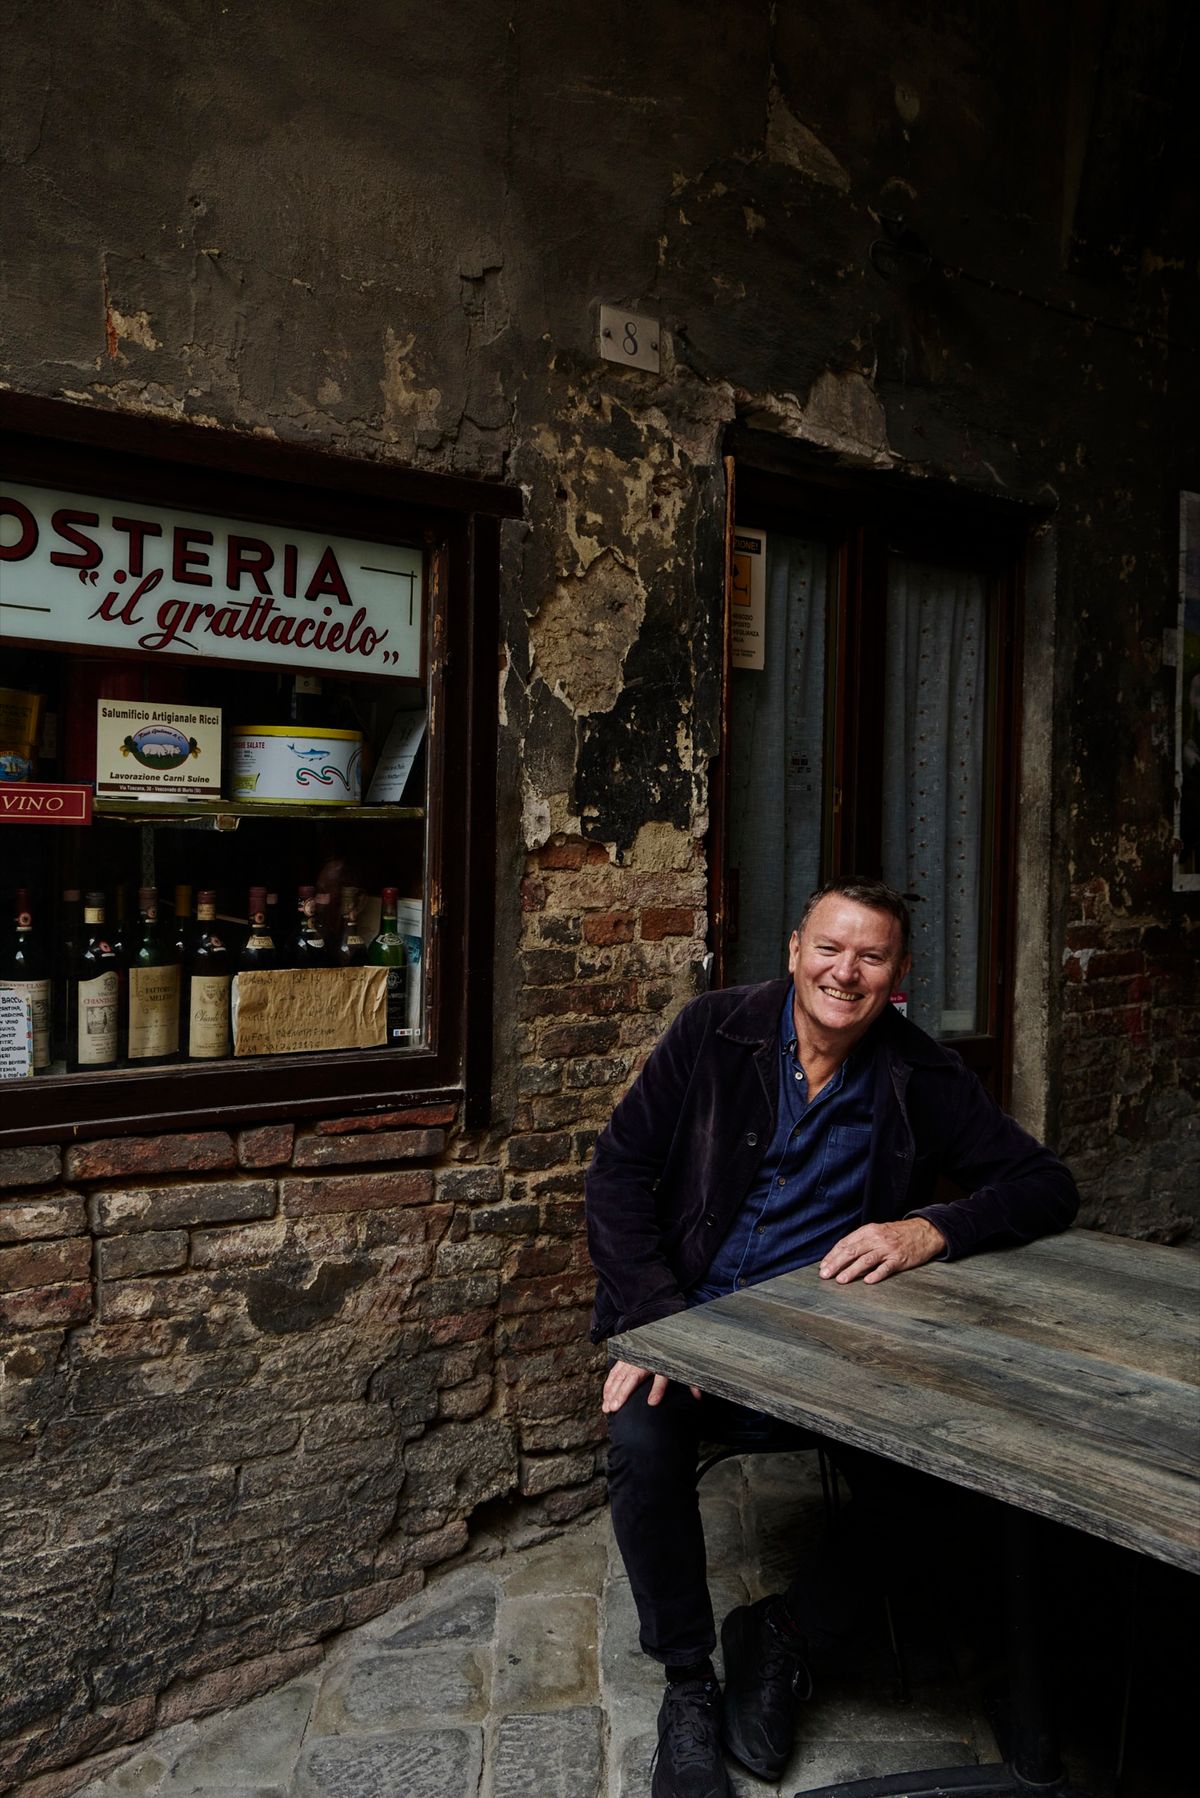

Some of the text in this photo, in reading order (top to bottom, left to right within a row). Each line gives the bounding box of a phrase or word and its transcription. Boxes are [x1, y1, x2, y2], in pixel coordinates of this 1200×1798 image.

[623, 322, 638, 355] 8
[101, 707, 219, 726] Salumificio Artigianale Ricci
[246, 741, 265, 749] SALATE
[109, 772, 210, 784] Lavorazione Carni Suine
[1, 795, 64, 811] VINO
